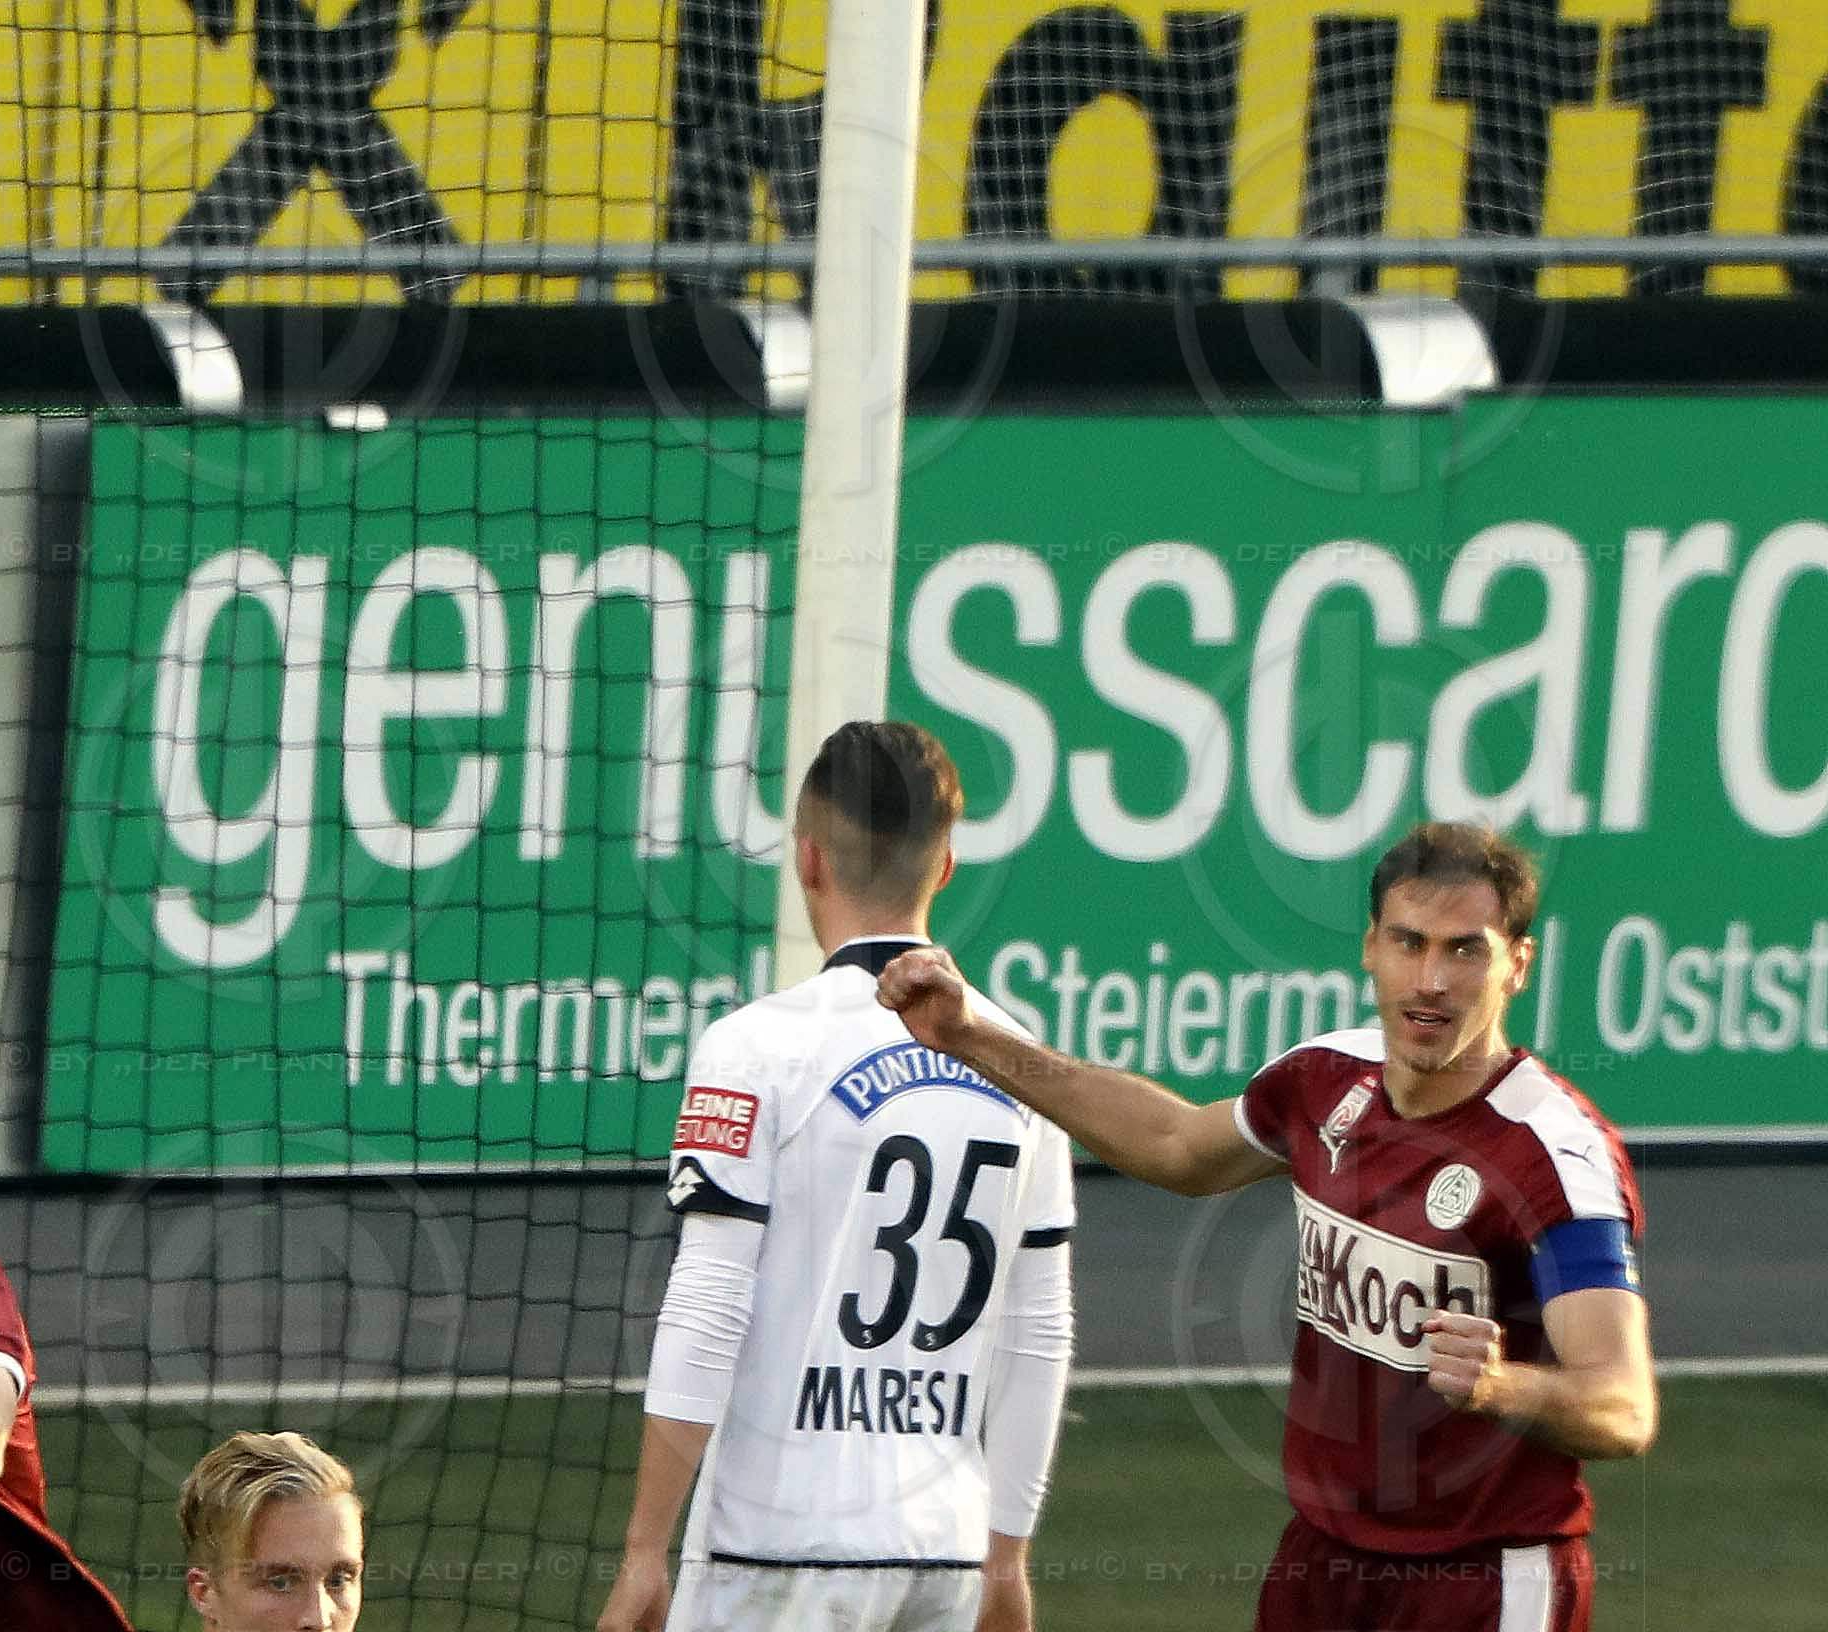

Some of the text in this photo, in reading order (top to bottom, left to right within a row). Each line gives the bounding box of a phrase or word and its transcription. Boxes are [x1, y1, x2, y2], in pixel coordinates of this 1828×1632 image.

[987, 940, 1376, 1078] Steierm
[837, 1134, 1020, 1351] 35
[795, 1366, 970, 1435] MARESI
